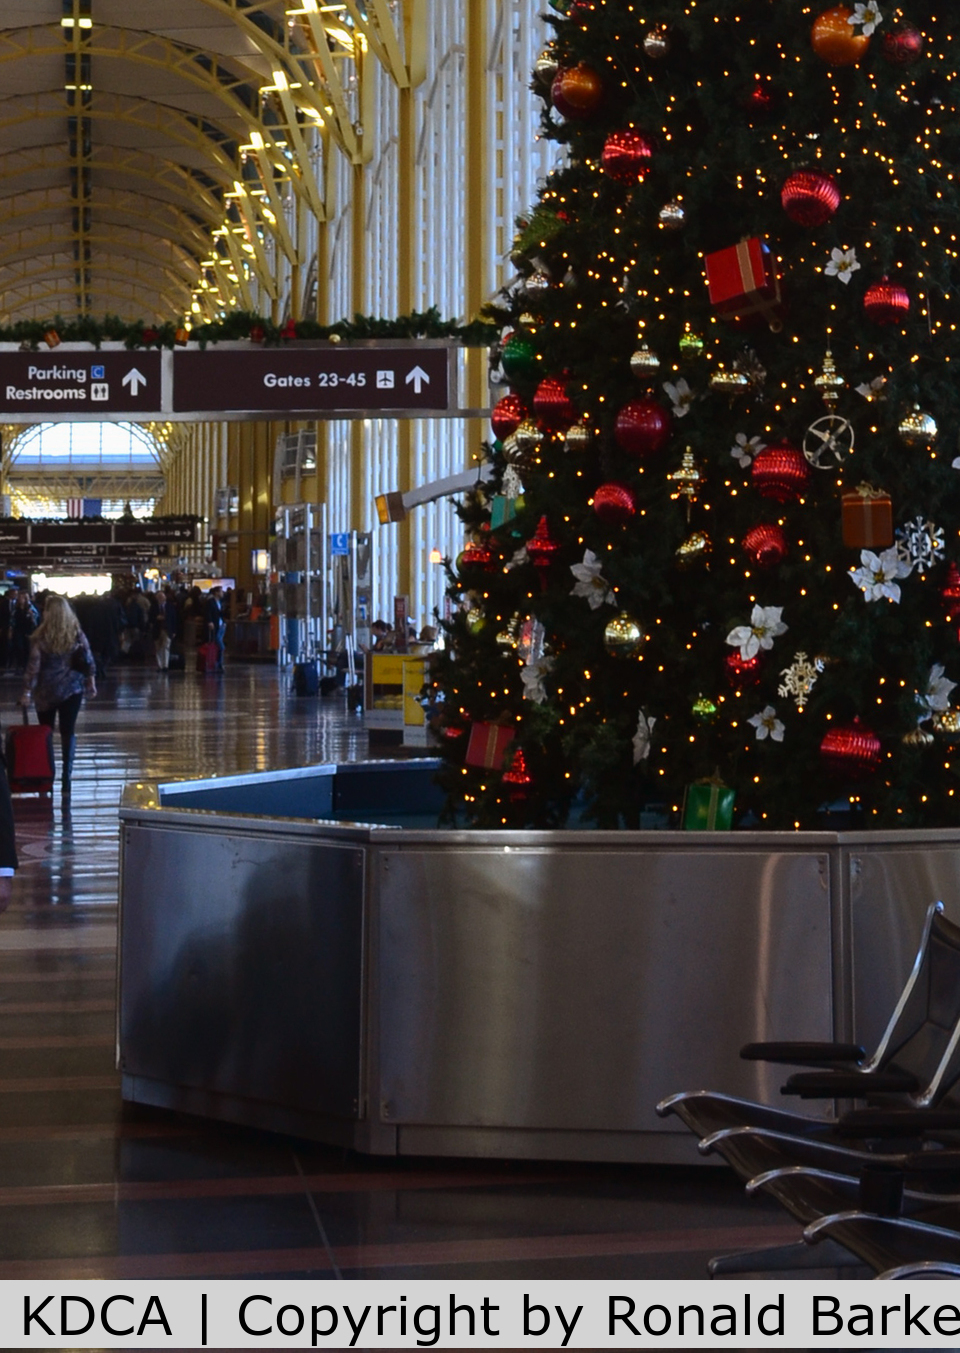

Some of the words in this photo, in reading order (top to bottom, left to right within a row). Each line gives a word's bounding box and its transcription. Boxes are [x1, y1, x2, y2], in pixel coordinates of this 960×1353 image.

[28, 365, 87, 383] Parking
[263, 373, 311, 387] Gates
[318, 372, 366, 387] 23-45
[6, 385, 87, 400] Restrooms
